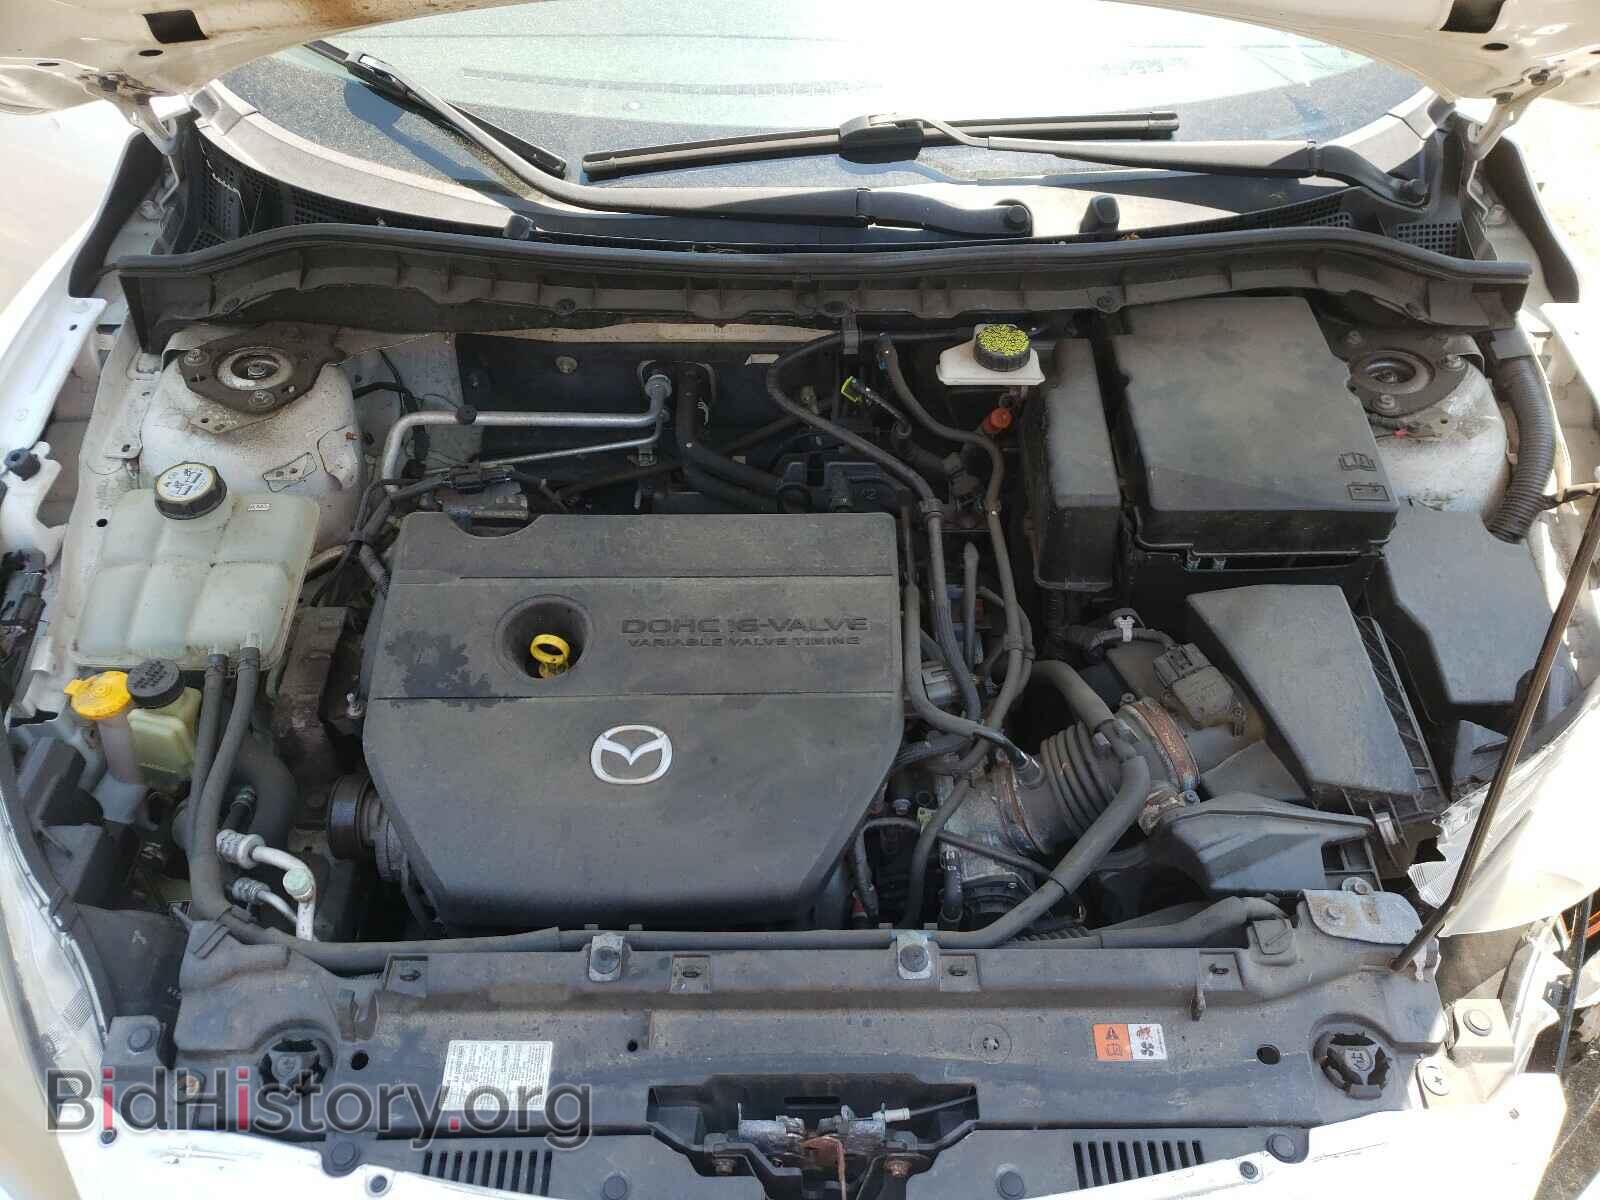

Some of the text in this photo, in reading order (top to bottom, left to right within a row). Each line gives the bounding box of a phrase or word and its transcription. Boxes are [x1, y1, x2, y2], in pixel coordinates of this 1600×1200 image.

[621, 616, 869, 634] DOHC 16-VALVE
[627, 637, 724, 648] VARIABLE
[728, 637, 790, 648] VALVE
